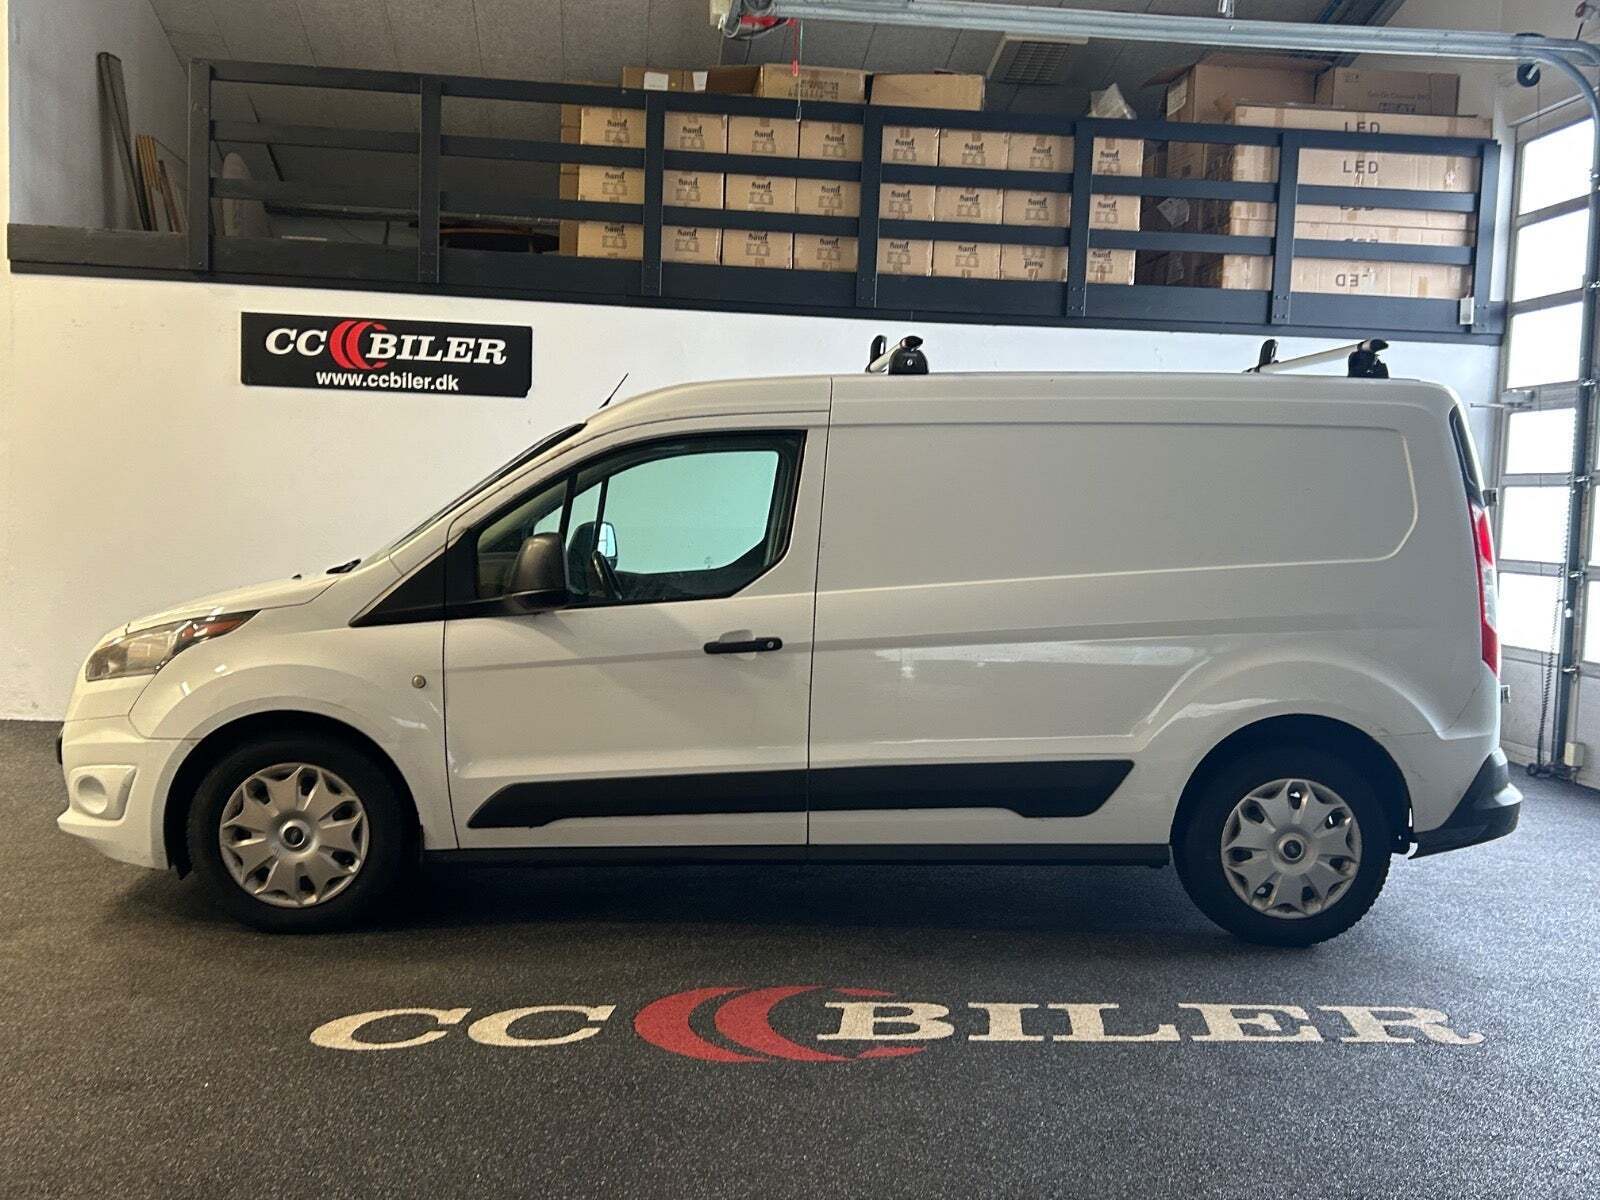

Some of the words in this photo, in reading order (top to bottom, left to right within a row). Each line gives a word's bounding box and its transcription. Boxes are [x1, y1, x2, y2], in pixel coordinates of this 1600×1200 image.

[1344, 121, 1380, 134] LED
[1343, 160, 1379, 174] LED
[1335, 273, 1370, 287] ED
[366, 333, 508, 365] BILER
[316, 372, 459, 391] www.ccbiler.dk
[817, 1001, 1483, 1044] BILER
